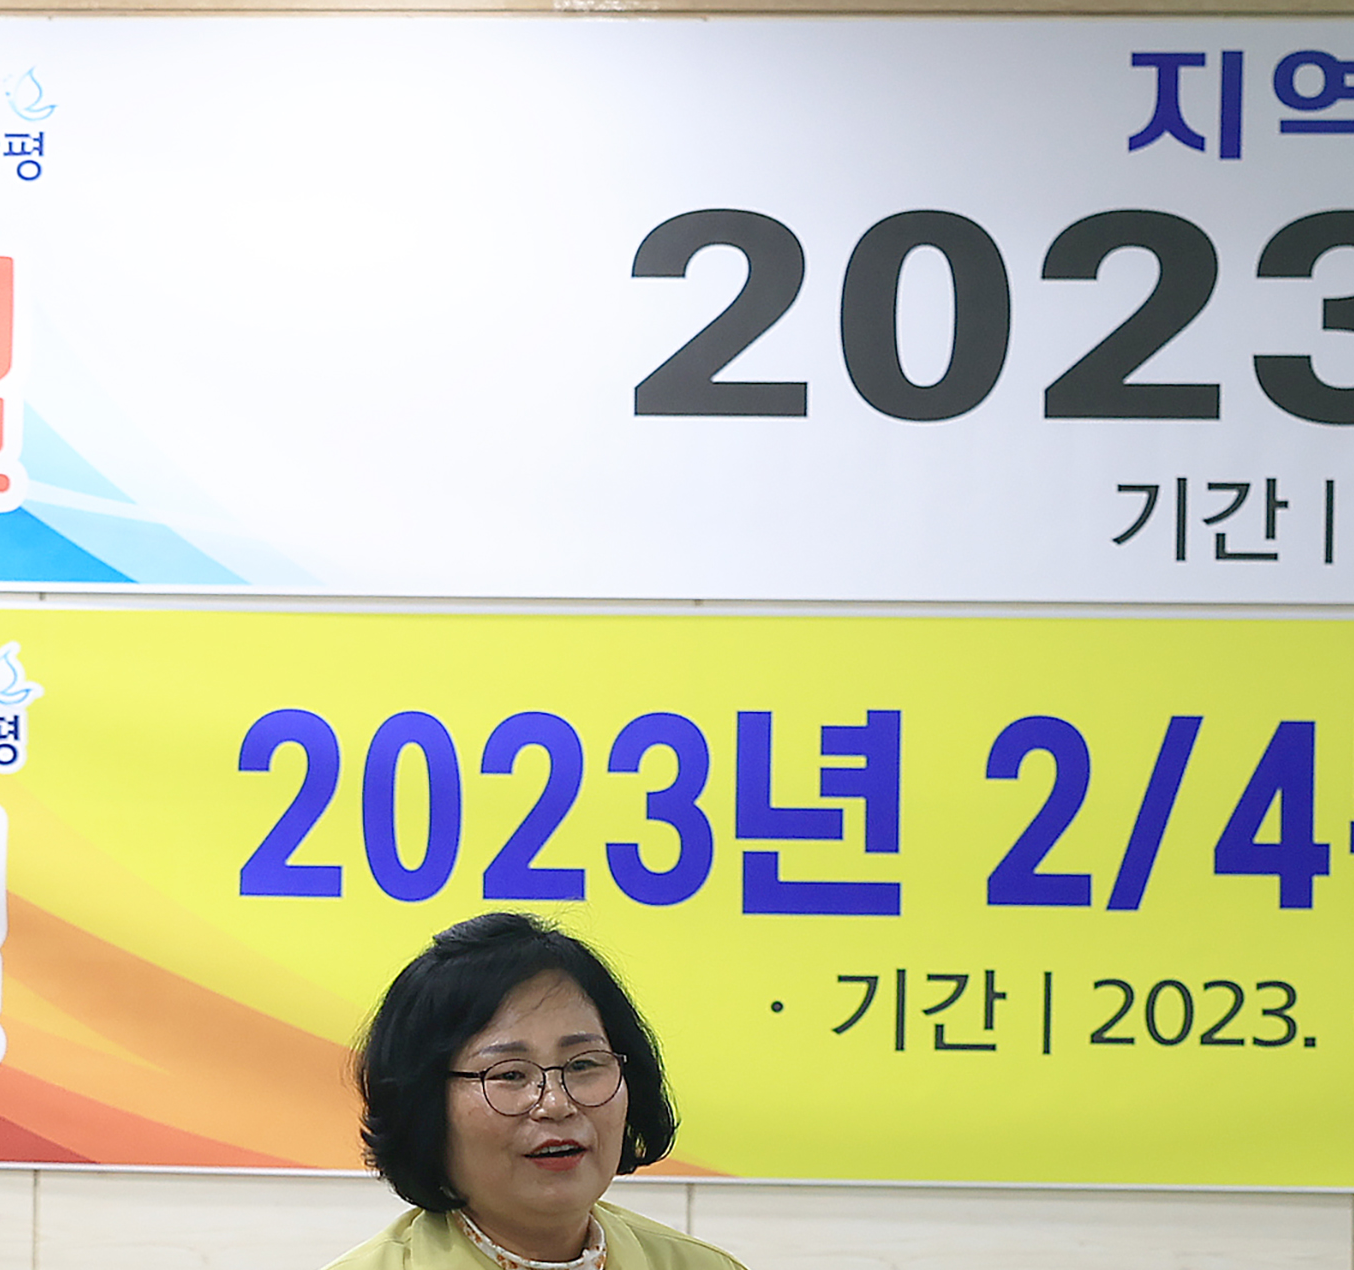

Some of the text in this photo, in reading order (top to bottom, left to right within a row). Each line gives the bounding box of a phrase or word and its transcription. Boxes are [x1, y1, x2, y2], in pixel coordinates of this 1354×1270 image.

[1112, 477, 1289, 562] 기간
[238, 708, 902, 917] 2023년
[832, 968, 1007, 1052] 기간
[1090, 978, 1317, 1048] 2023.
